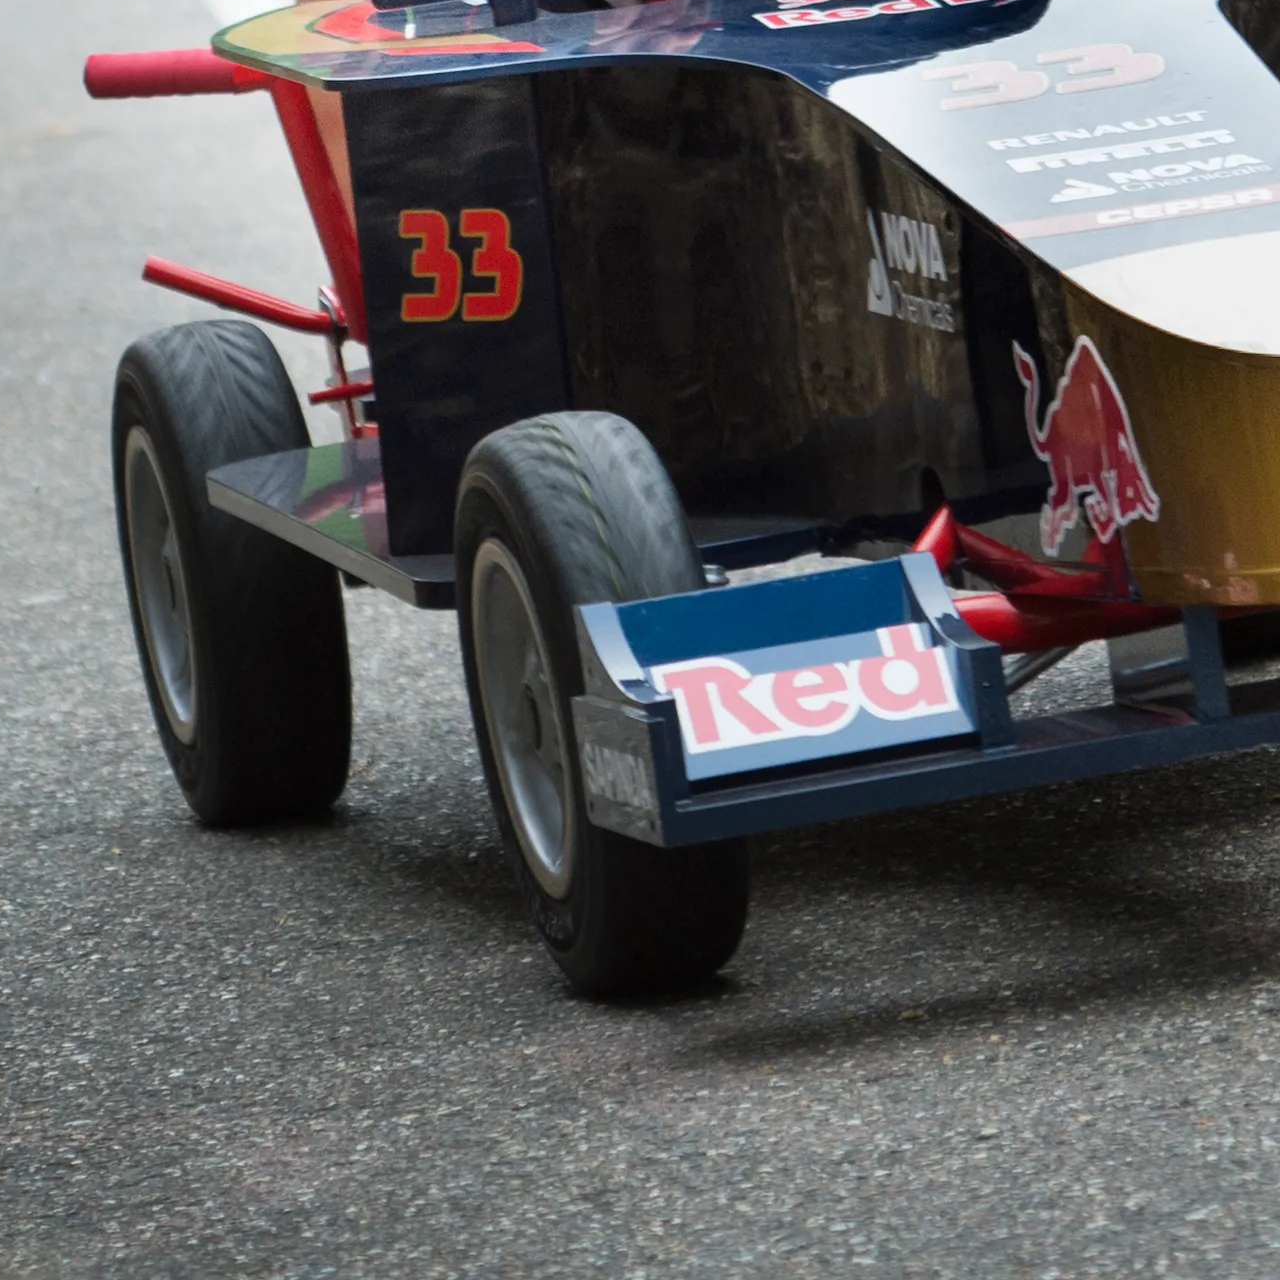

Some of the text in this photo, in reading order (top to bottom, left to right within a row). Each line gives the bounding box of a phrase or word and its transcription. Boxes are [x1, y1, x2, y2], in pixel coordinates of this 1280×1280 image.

[922, 43, 1166, 111] 33
[986, 110, 1209, 151] RENAULT
[1107, 154, 1265, 185] NOVA
[1121, 163, 1275, 193] Chemicals
[1095, 188, 1273, 225] CEPSA
[398, 208, 523, 322] 33
[880, 211, 949, 282] NOVA
[654, 622, 957, 751] Red
